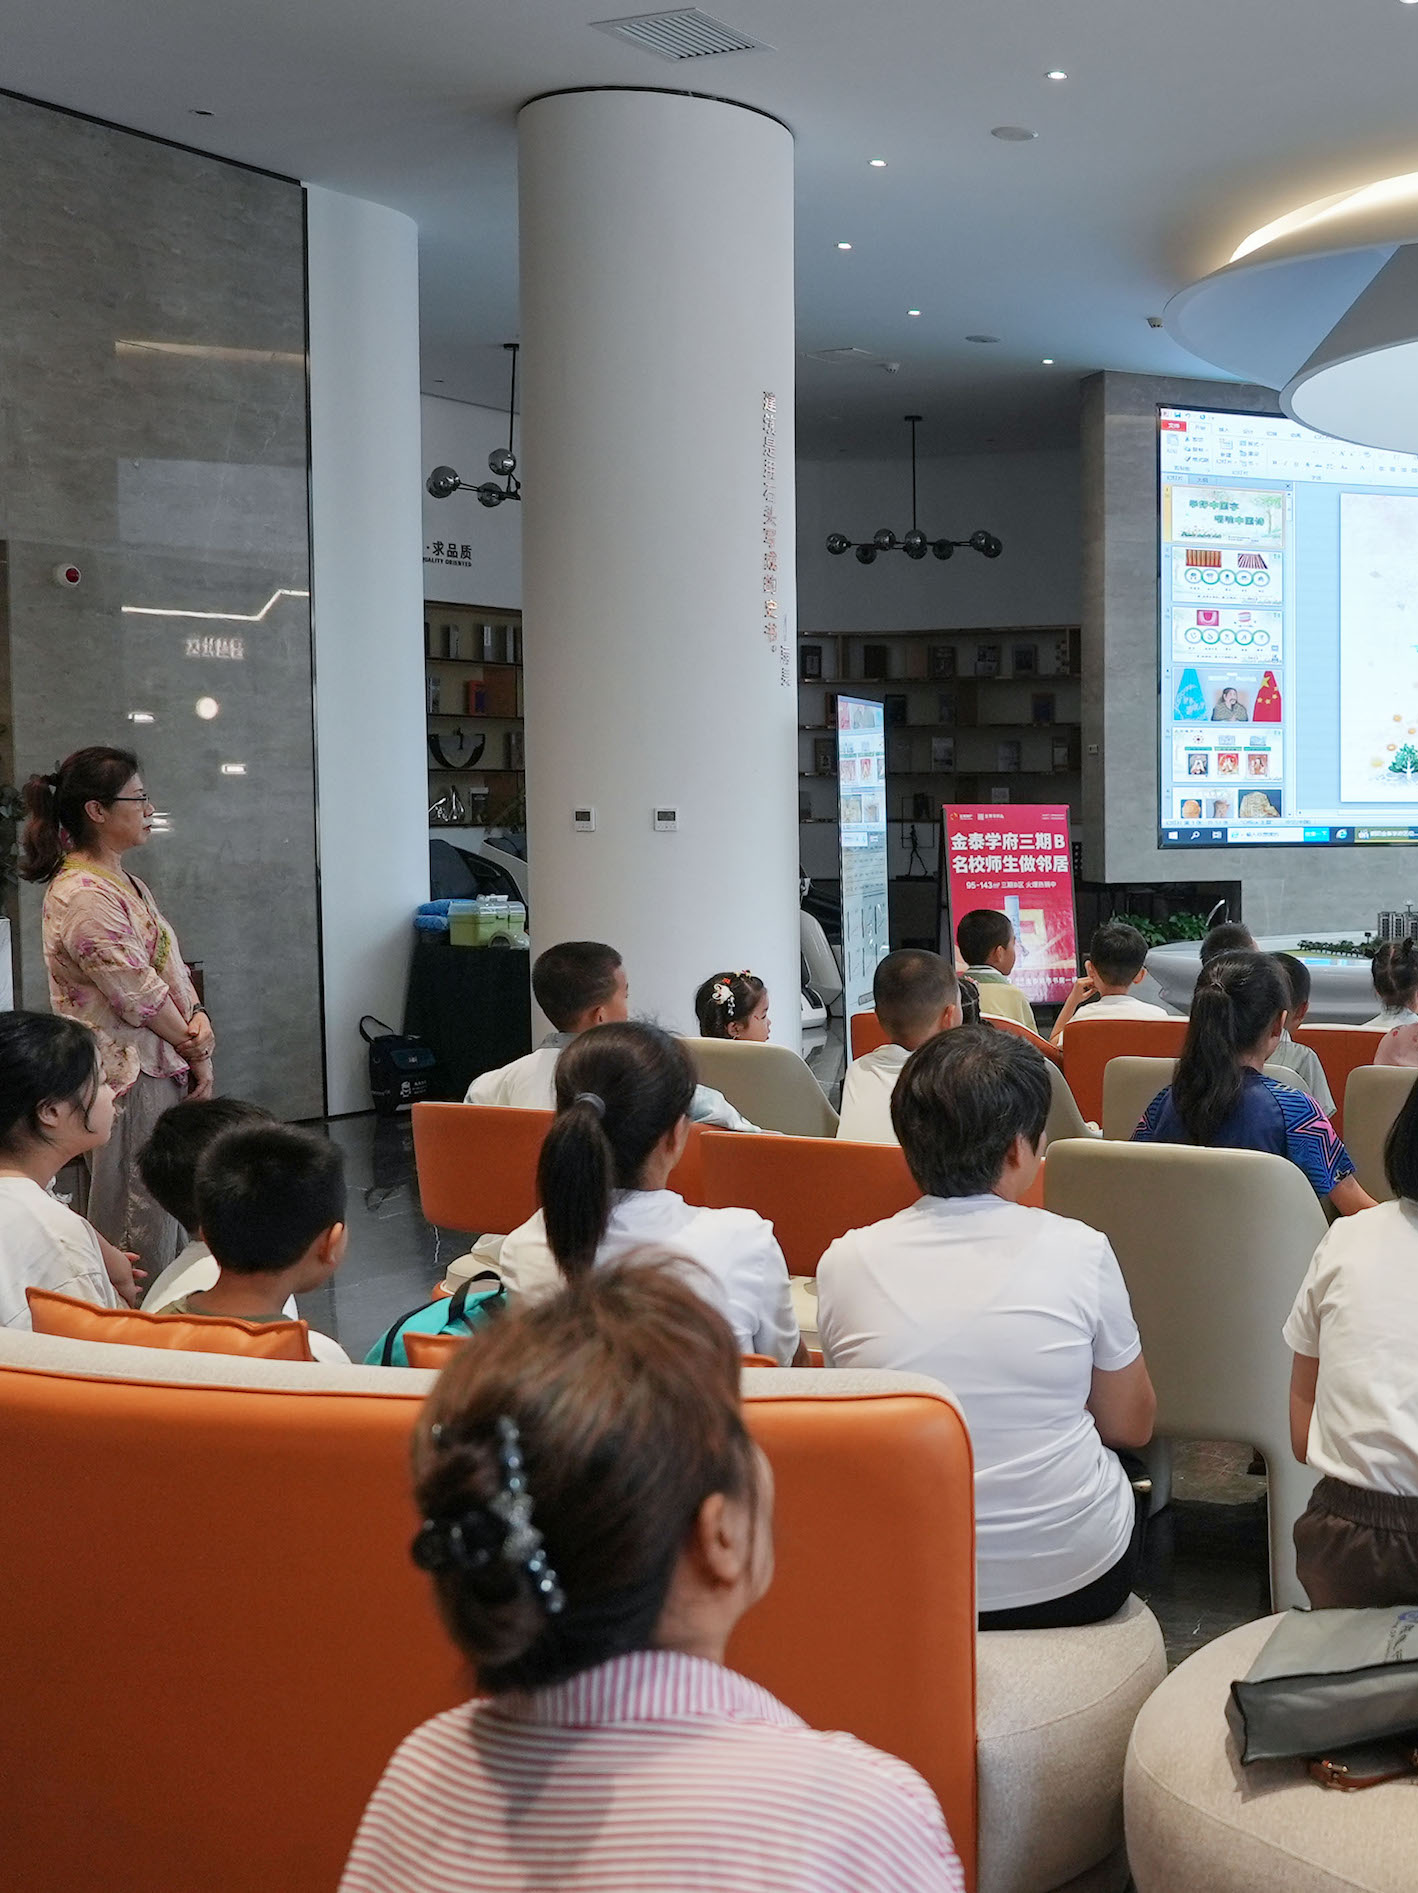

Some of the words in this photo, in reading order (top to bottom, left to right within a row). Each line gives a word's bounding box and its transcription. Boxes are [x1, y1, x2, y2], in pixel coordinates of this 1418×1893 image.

[951, 832, 1066, 851] 金泰学府三期B
[952, 854, 1069, 874] 名校师生做邻居
